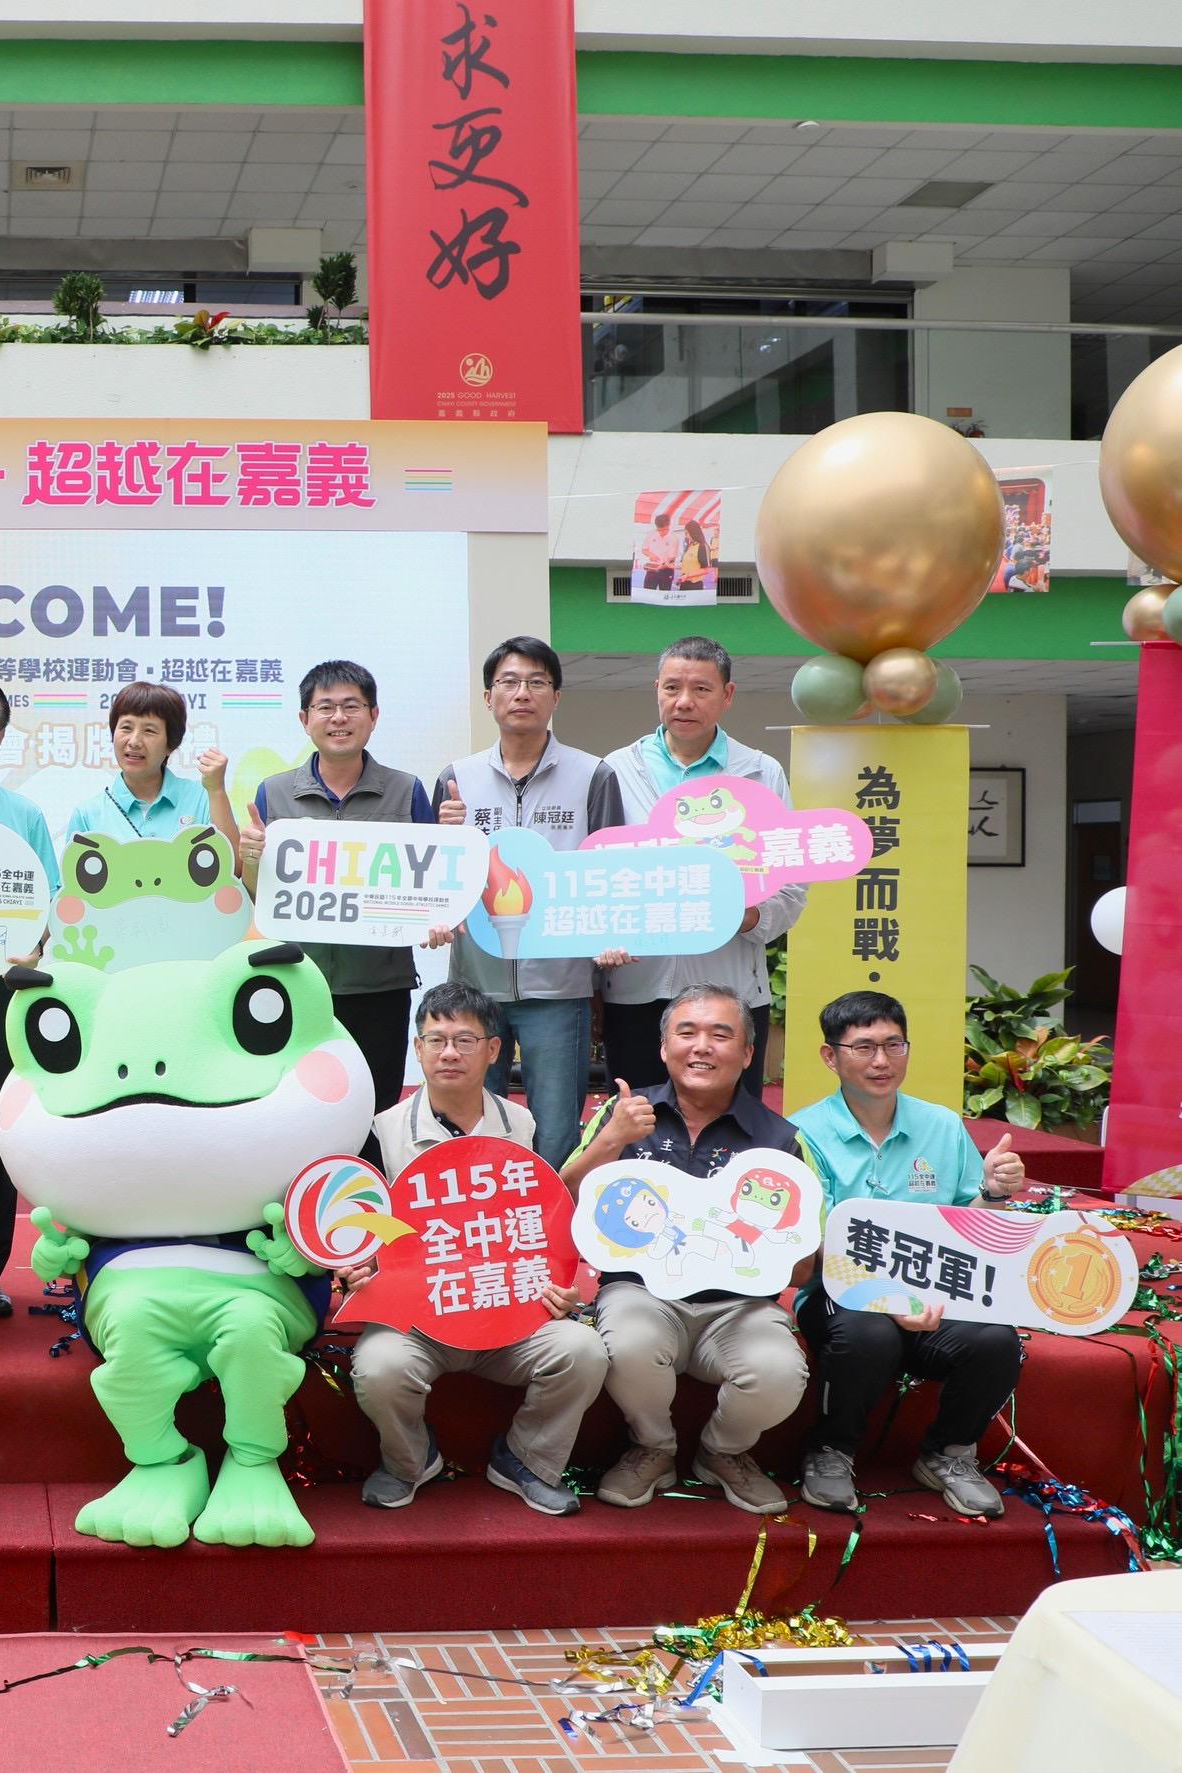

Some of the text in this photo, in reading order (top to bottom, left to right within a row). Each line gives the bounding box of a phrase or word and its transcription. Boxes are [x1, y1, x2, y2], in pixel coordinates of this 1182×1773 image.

[427, 3, 529, 301] 求更好
[458, 391, 482, 399] GOOD
[486, 391, 516, 399] HARVEST
[533, 811, 575, 825] 陳冠廷
[275, 838, 466, 891] CHIAYI
[759, 823, 856, 868] 嘉義
[543, 864, 711, 899] 115全中運
[273, 889, 360, 923] 2026
[541, 901, 715, 937] 超越在嘉義
[407, 1159, 539, 1210] 115年
[420, 1204, 549, 1265] 全中運
[425, 1254, 553, 1316] 在嘉義
